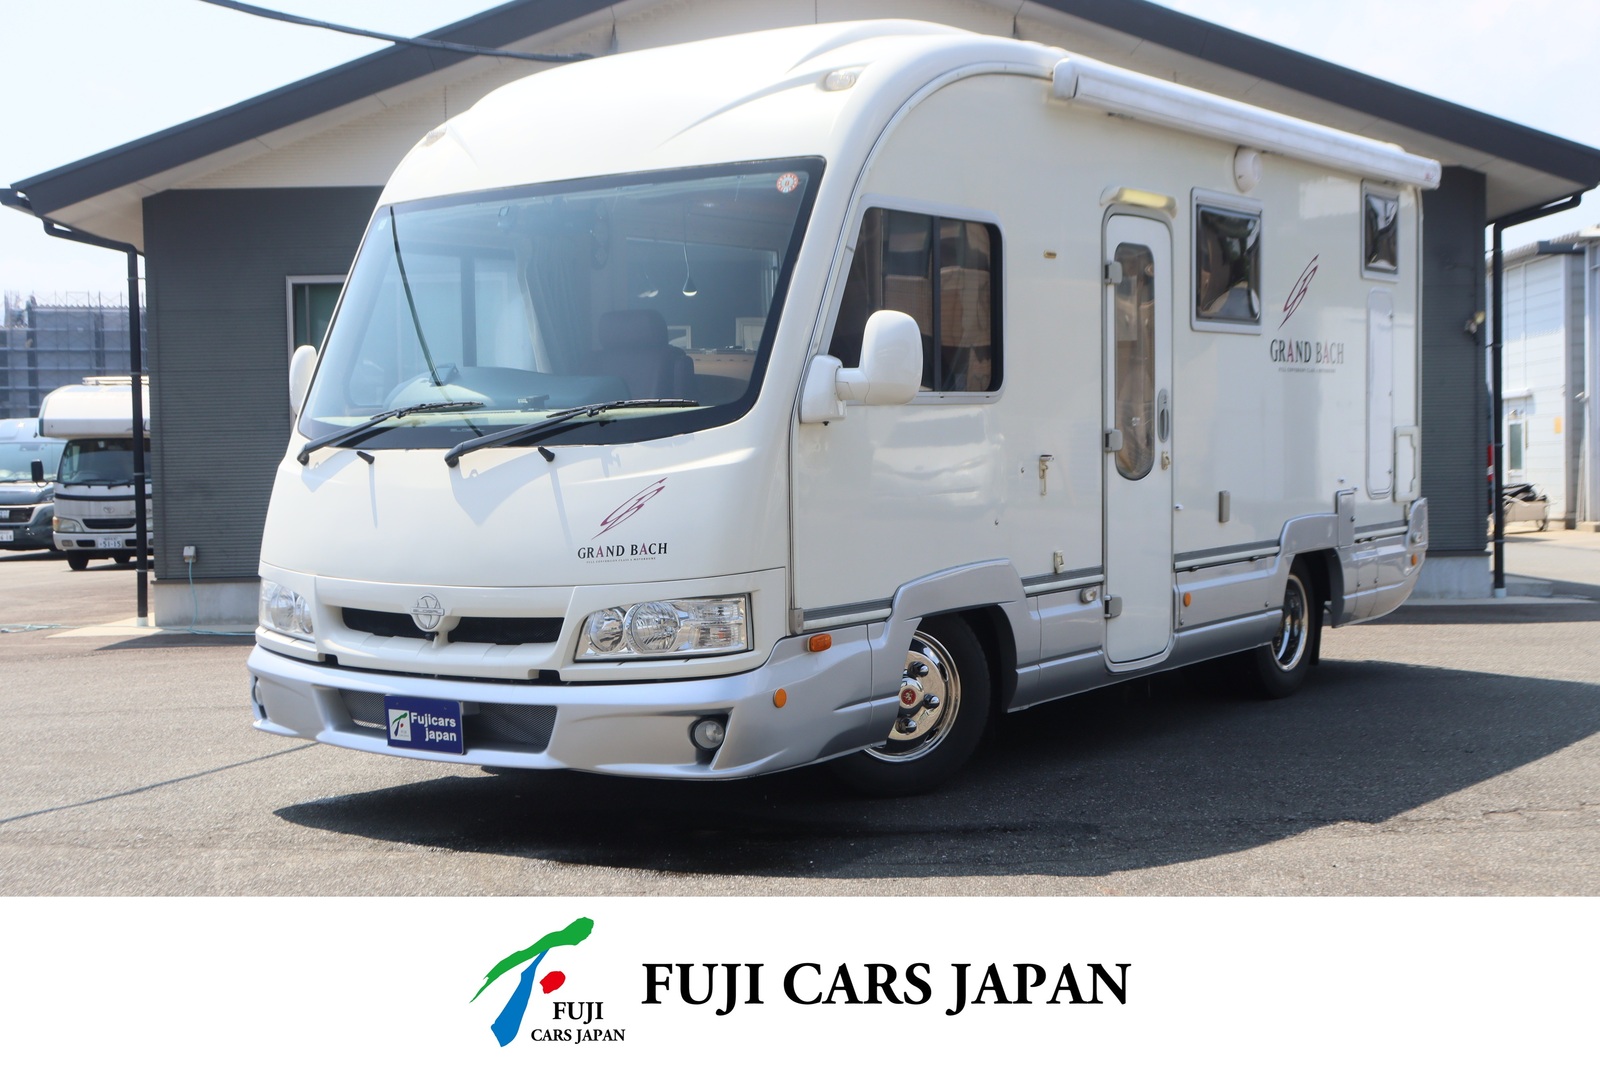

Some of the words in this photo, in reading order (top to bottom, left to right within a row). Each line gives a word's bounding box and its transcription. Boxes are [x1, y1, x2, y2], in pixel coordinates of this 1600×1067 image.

[1270, 338, 1312, 363] GRAND
[1315, 339, 1344, 364] BACH
[577, 545, 625, 559] GRAND
[631, 543, 668, 556] BACH
[410, 712, 457, 728] Fujicars
[425, 728, 457, 742] japan
